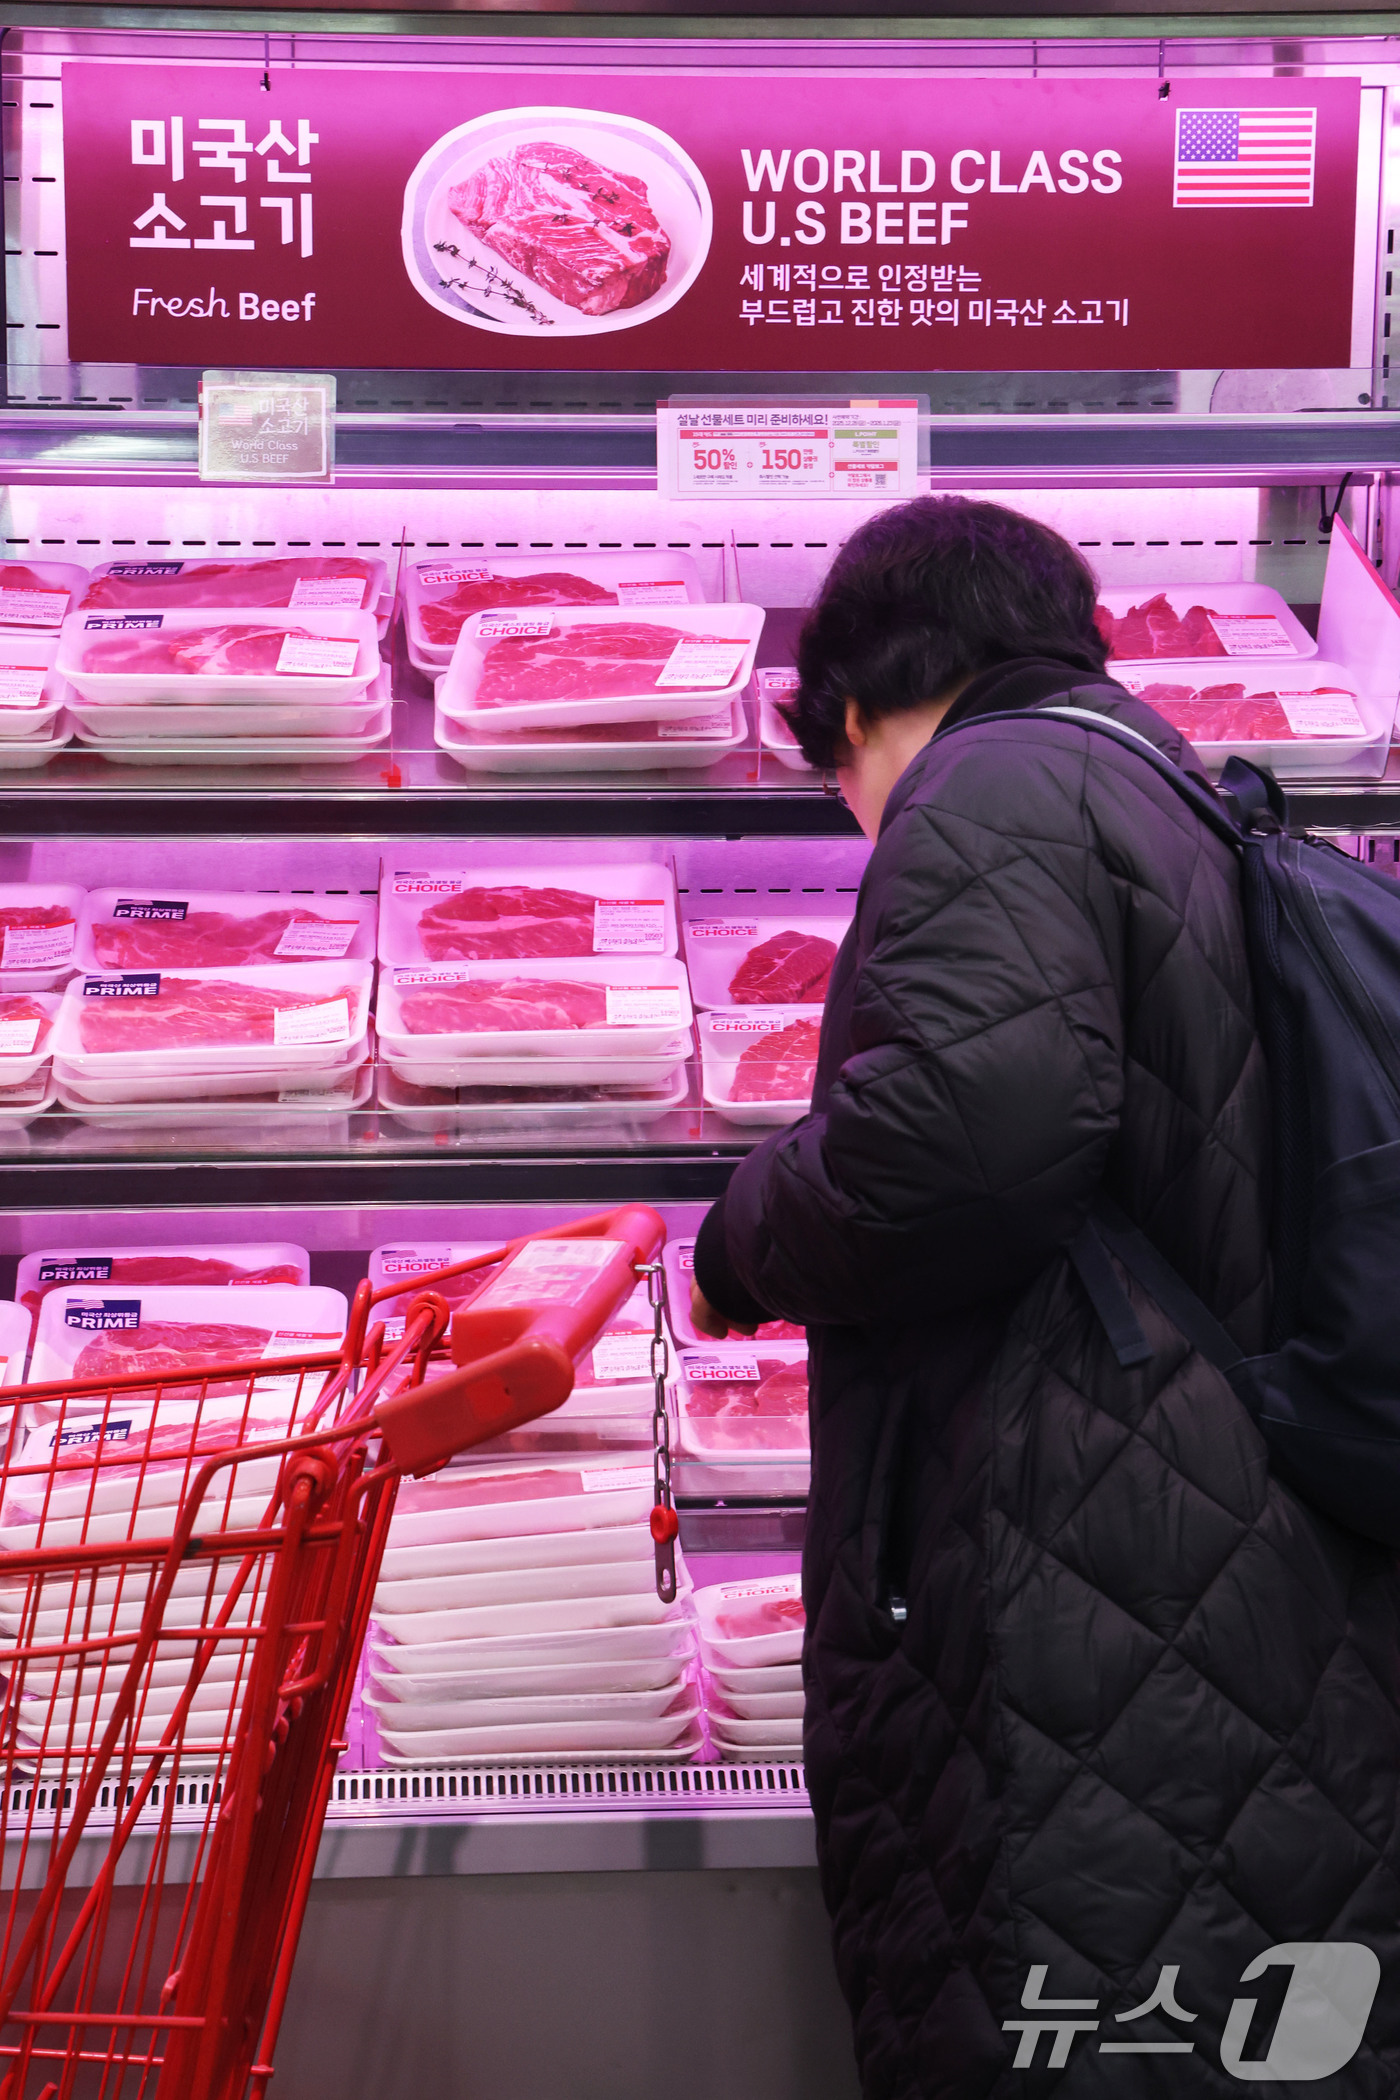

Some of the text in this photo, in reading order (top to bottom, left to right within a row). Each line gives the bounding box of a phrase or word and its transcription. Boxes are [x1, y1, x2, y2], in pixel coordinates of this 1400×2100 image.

[130, 116, 319, 183] 미국산
[741, 148, 1123, 194] WORLD CLASS
[129, 192, 313, 258] 소고기
[742, 201, 969, 247] U.S BEEF
[740, 263, 982, 292] 세계적으로 인정받는
[133, 287, 316, 322] Fresh Beef
[739, 299, 1129, 326] 부드럽고 진한 맛의 미국산 소고기
[260, 397, 309, 416] 미국산
[677, 413, 829, 426] 설날 선물세트 미리 준비하세요!
[259, 417, 308, 435] 소고기
[232, 440, 298, 450] World Class
[240, 453, 289, 464] U.S BEEF
[693, 448, 736, 470] 50%
[762, 449, 802, 470] 150
[723, 461, 738, 470] 할인
[423, 572, 490, 584] CHOICE
[87, 621, 160, 629] PRIME
[480, 625, 548, 637] CHOICE
[395, 884, 462, 892] CHOICE
[116, 909, 184, 920] PRIME
[692, 929, 759, 937] CHOICE
[397, 974, 467, 984] CHOICE
[86, 987, 157, 995] PRIME
[712, 1023, 782, 1031] CHOICE
[385, 1261, 450, 1272] CHOICE
[41, 1270, 108, 1280] PRIME
[67, 1315, 138, 1329] PRIME
[689, 1369, 758, 1379] CHOICE
[724, 1587, 796, 1599] CHOICE
